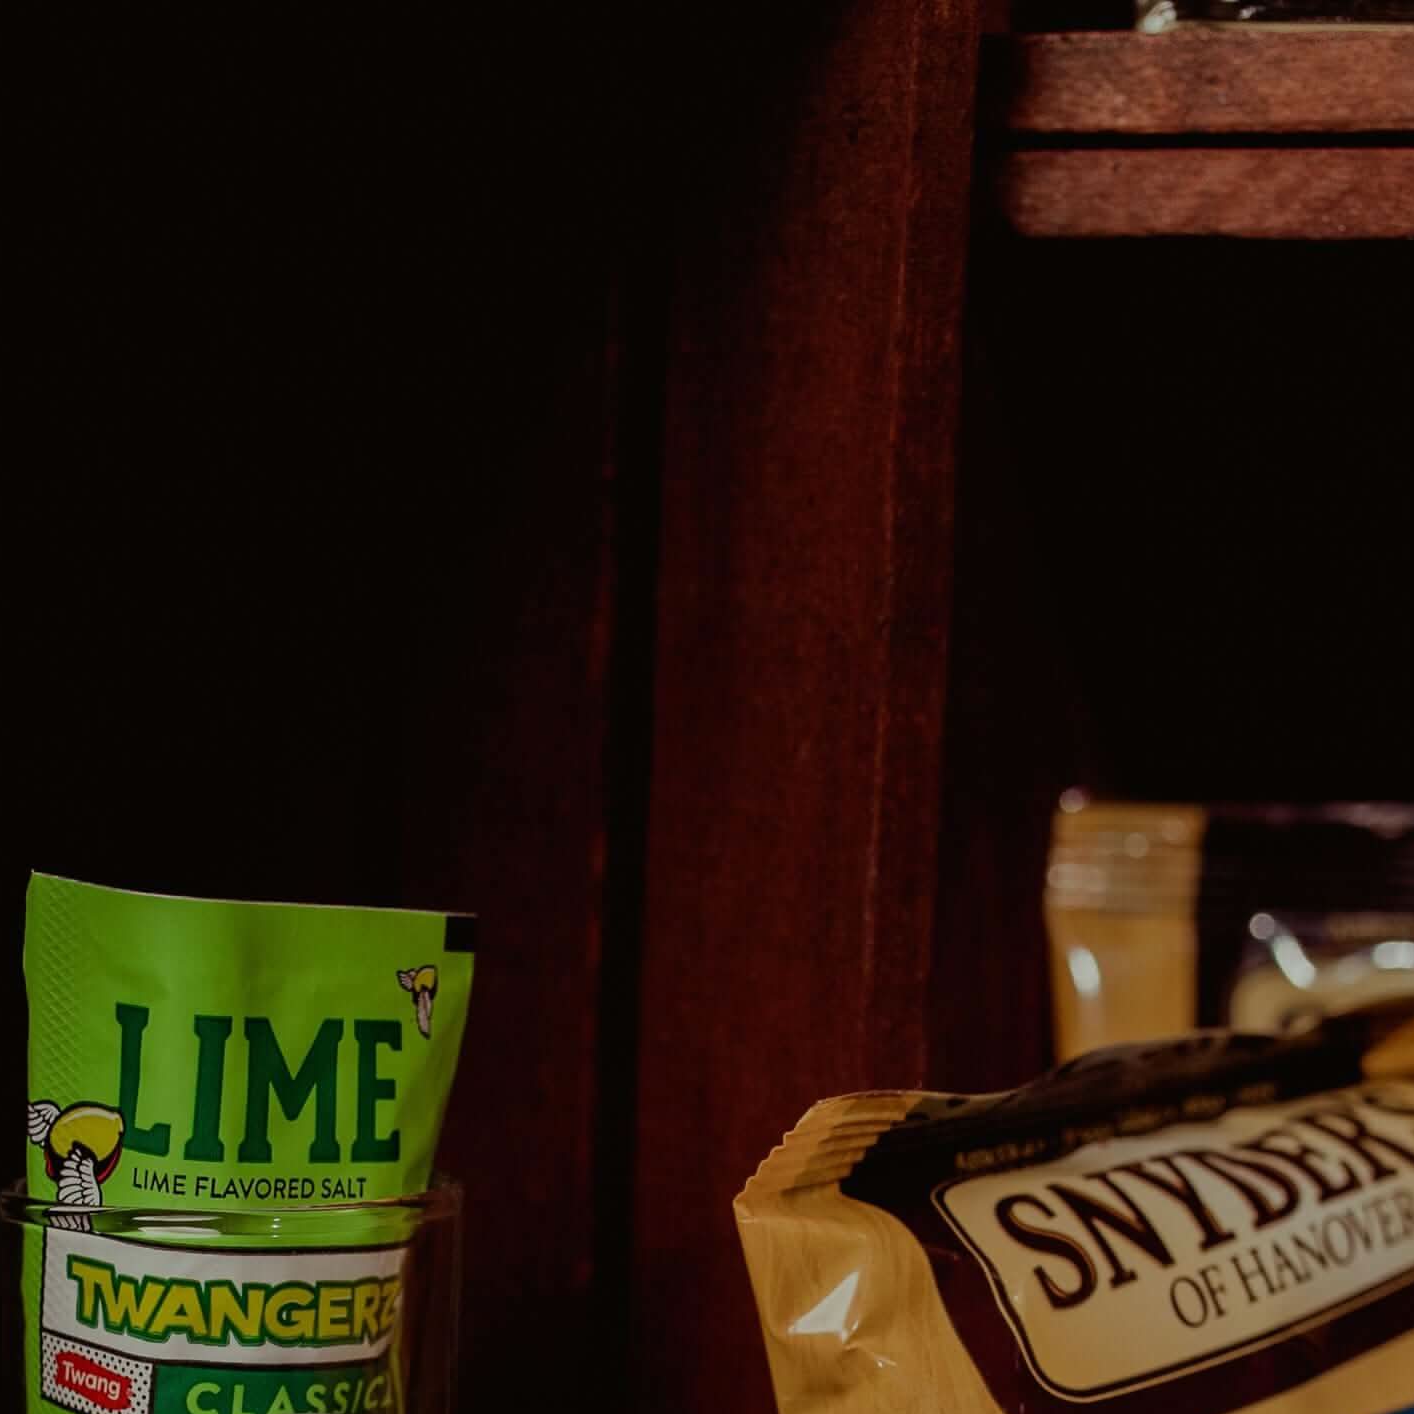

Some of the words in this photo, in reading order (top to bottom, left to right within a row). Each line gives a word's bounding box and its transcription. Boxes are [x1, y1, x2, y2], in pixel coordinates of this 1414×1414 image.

[115, 1002, 402, 1164] LIME
[132, 1167, 187, 1197] LIME
[194, 1176, 316, 1201] FLAVORED
[321, 1177, 367, 1200] SALT
[1169, 1266, 1228, 1329] OF
[61, 1360, 122, 1401] Twang
